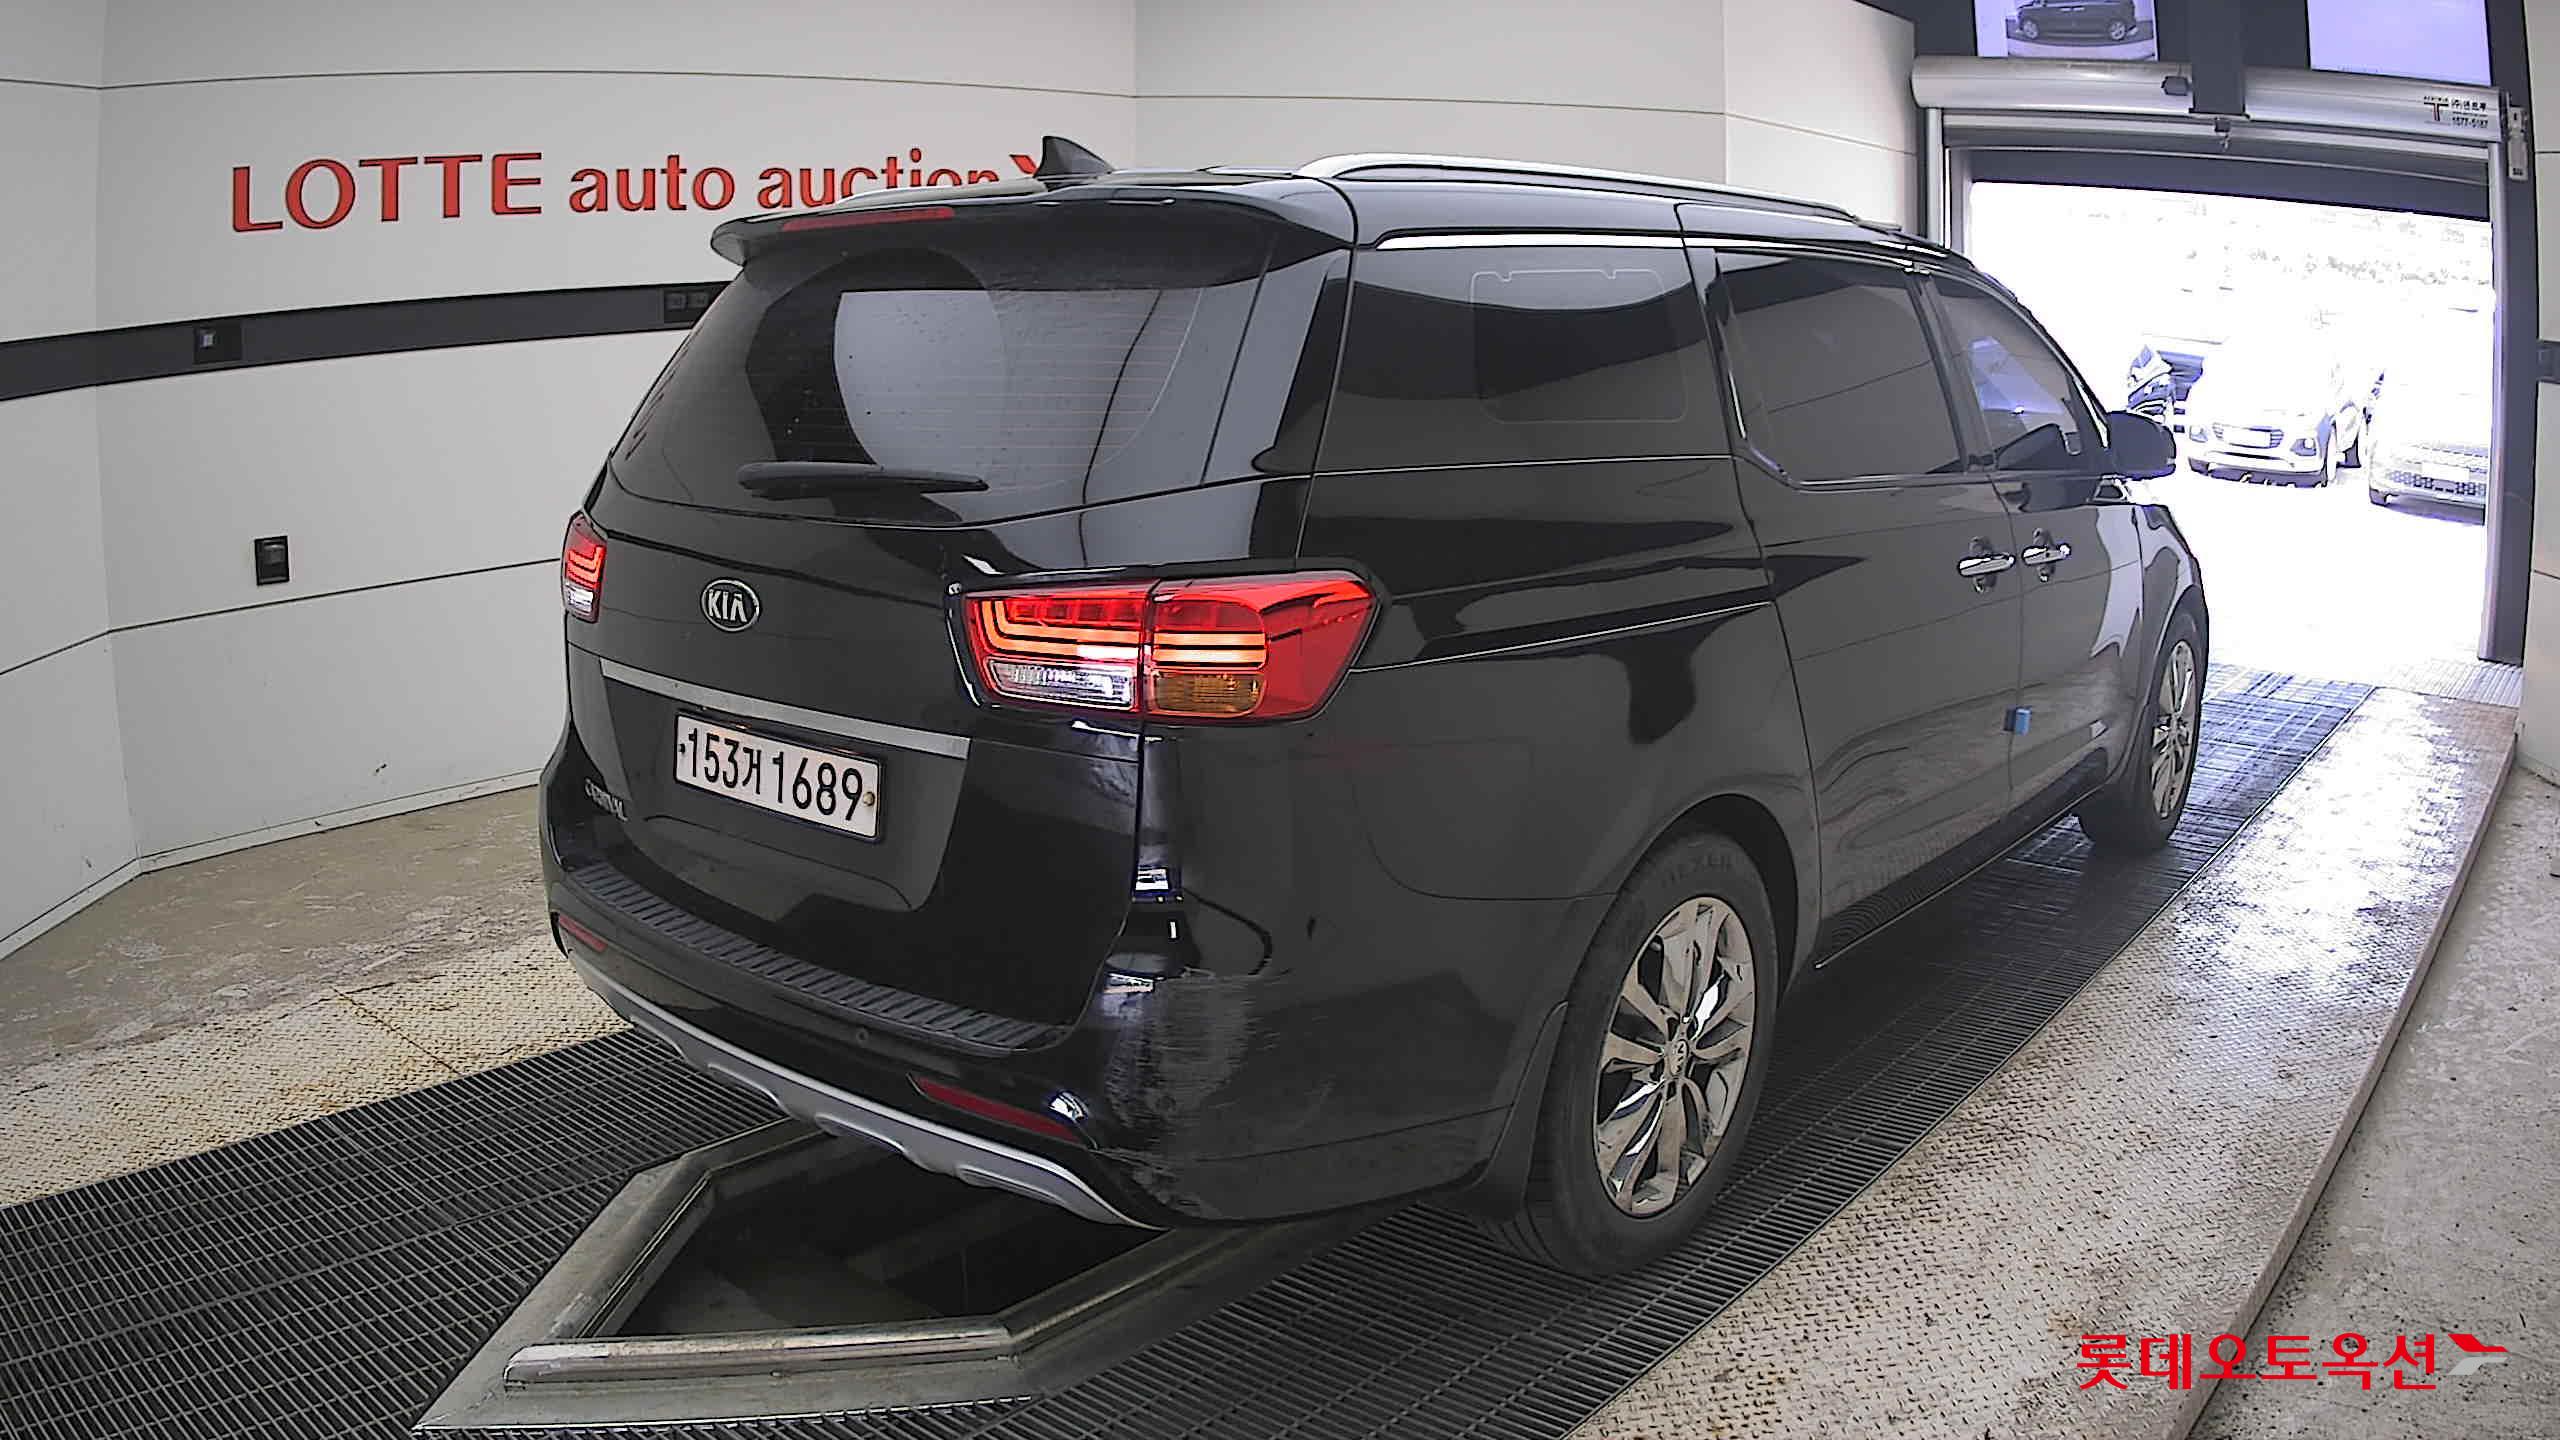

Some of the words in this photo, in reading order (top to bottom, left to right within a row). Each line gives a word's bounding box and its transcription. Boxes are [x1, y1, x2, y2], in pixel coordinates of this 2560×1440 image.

[232, 151, 543, 233] LOTTE
[568, 153, 736, 213] auto
[708, 588, 748, 622] KIA
